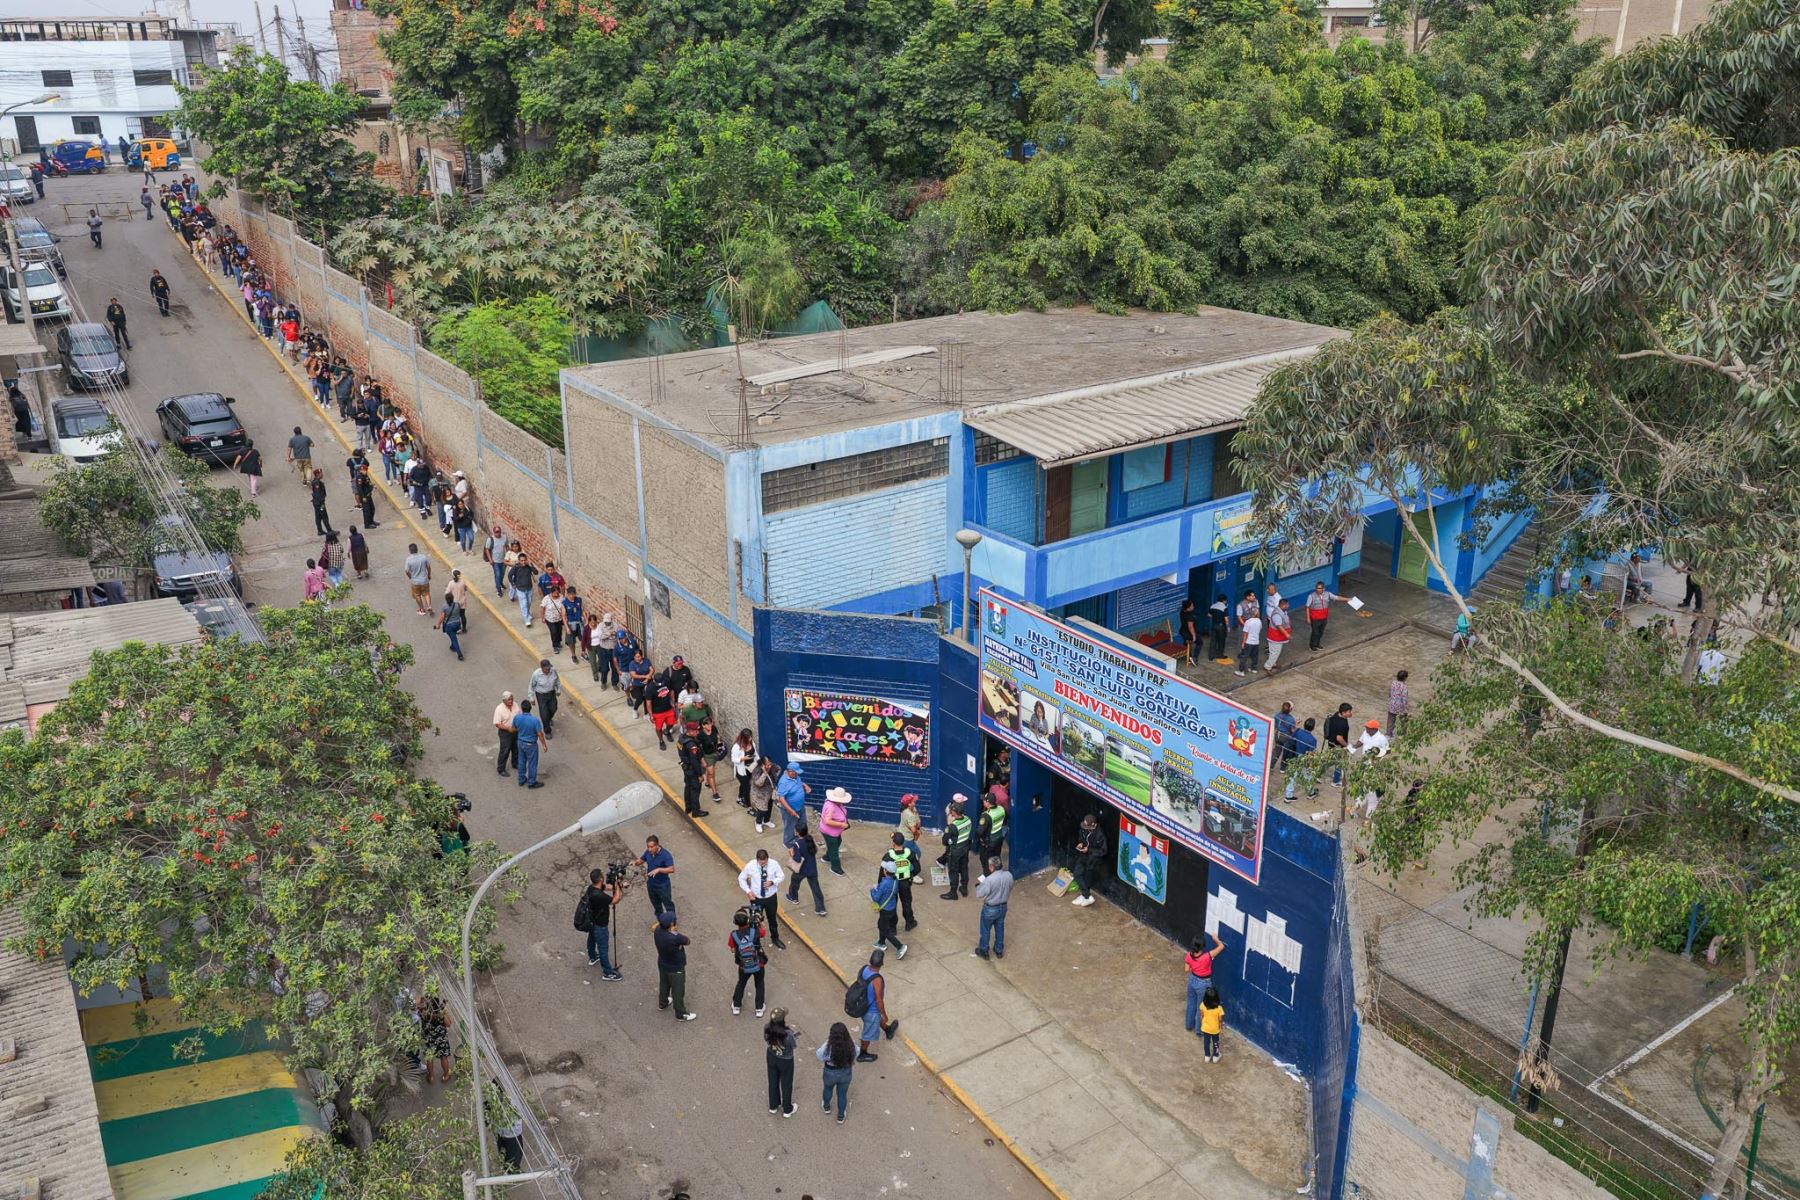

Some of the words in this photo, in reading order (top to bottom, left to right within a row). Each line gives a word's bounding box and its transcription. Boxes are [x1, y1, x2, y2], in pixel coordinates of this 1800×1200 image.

[1028, 628, 1112, 677] INSTITUCIÓN
[1116, 671, 1200, 719] EDUCATIVA
[1031, 643, 1058, 665] 6151
[1100, 677, 1131, 700] LUIS
[1098, 648, 1137, 674] TRABAJO
[1139, 667, 1146, 678] Y
[804, 696, 912, 718] Bienvenidos
[1040, 660, 1055, 673] Villa
[1056, 669, 1070, 680] San
[1072, 676, 1087, 689] Luis
[1093, 687, 1107, 699] San
[1109, 695, 1127, 709] Juan
[1129, 705, 1139, 715] de
[1141, 710, 1181, 736] Miraflores
[850, 716, 864, 726] a
[1054, 679, 1163, 747] BIENVENIDOS
[1209, 780, 1252, 805] INNOVACIÓN
[1216, 774, 1235, 789] AULA
[1236, 784, 1246, 793] DE
[1156, 840, 1164, 852] E
